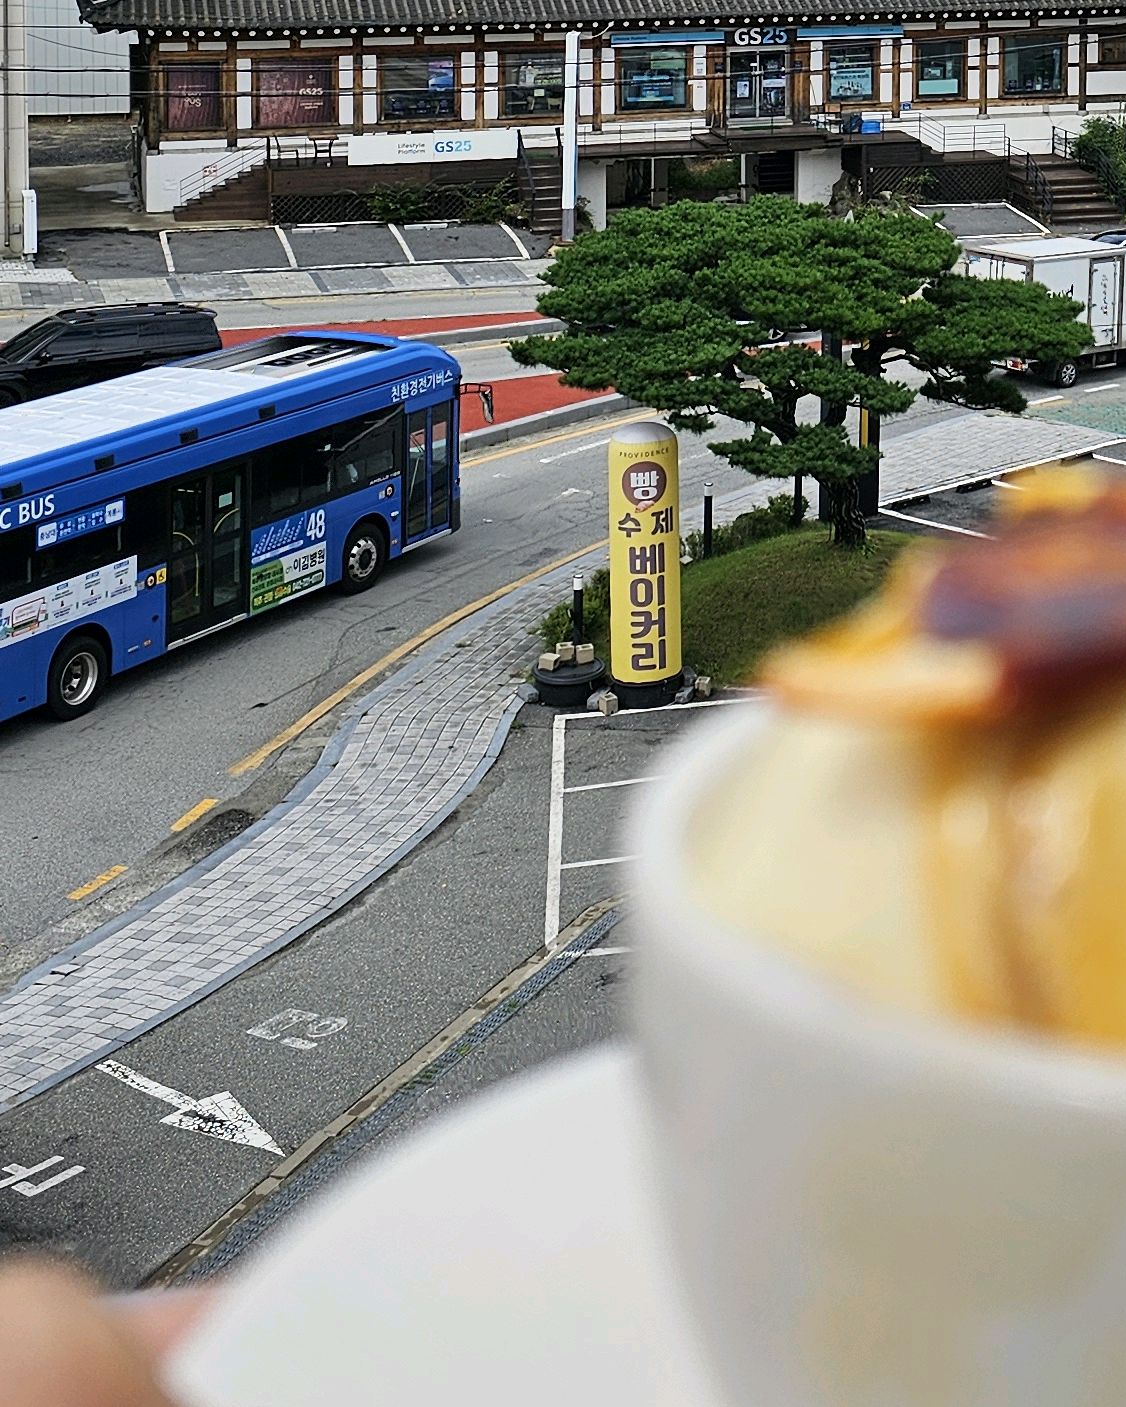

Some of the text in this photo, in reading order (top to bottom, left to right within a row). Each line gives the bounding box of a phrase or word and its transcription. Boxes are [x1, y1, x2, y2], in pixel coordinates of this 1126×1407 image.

[734, 28, 787, 45] GS25
[434, 140, 472, 152] GS25
[391, 369, 454, 403] 친환경전기버스
[619, 447, 669, 459] PROVIDENCE
[630, 470, 660, 500] 빵
[19, 494, 55, 524] BUS
[618, 505, 674, 538] 수제
[306, 509, 326, 541] 48
[293, 548, 326, 572] 이김병원
[629, 542, 667, 672] 베이커리
